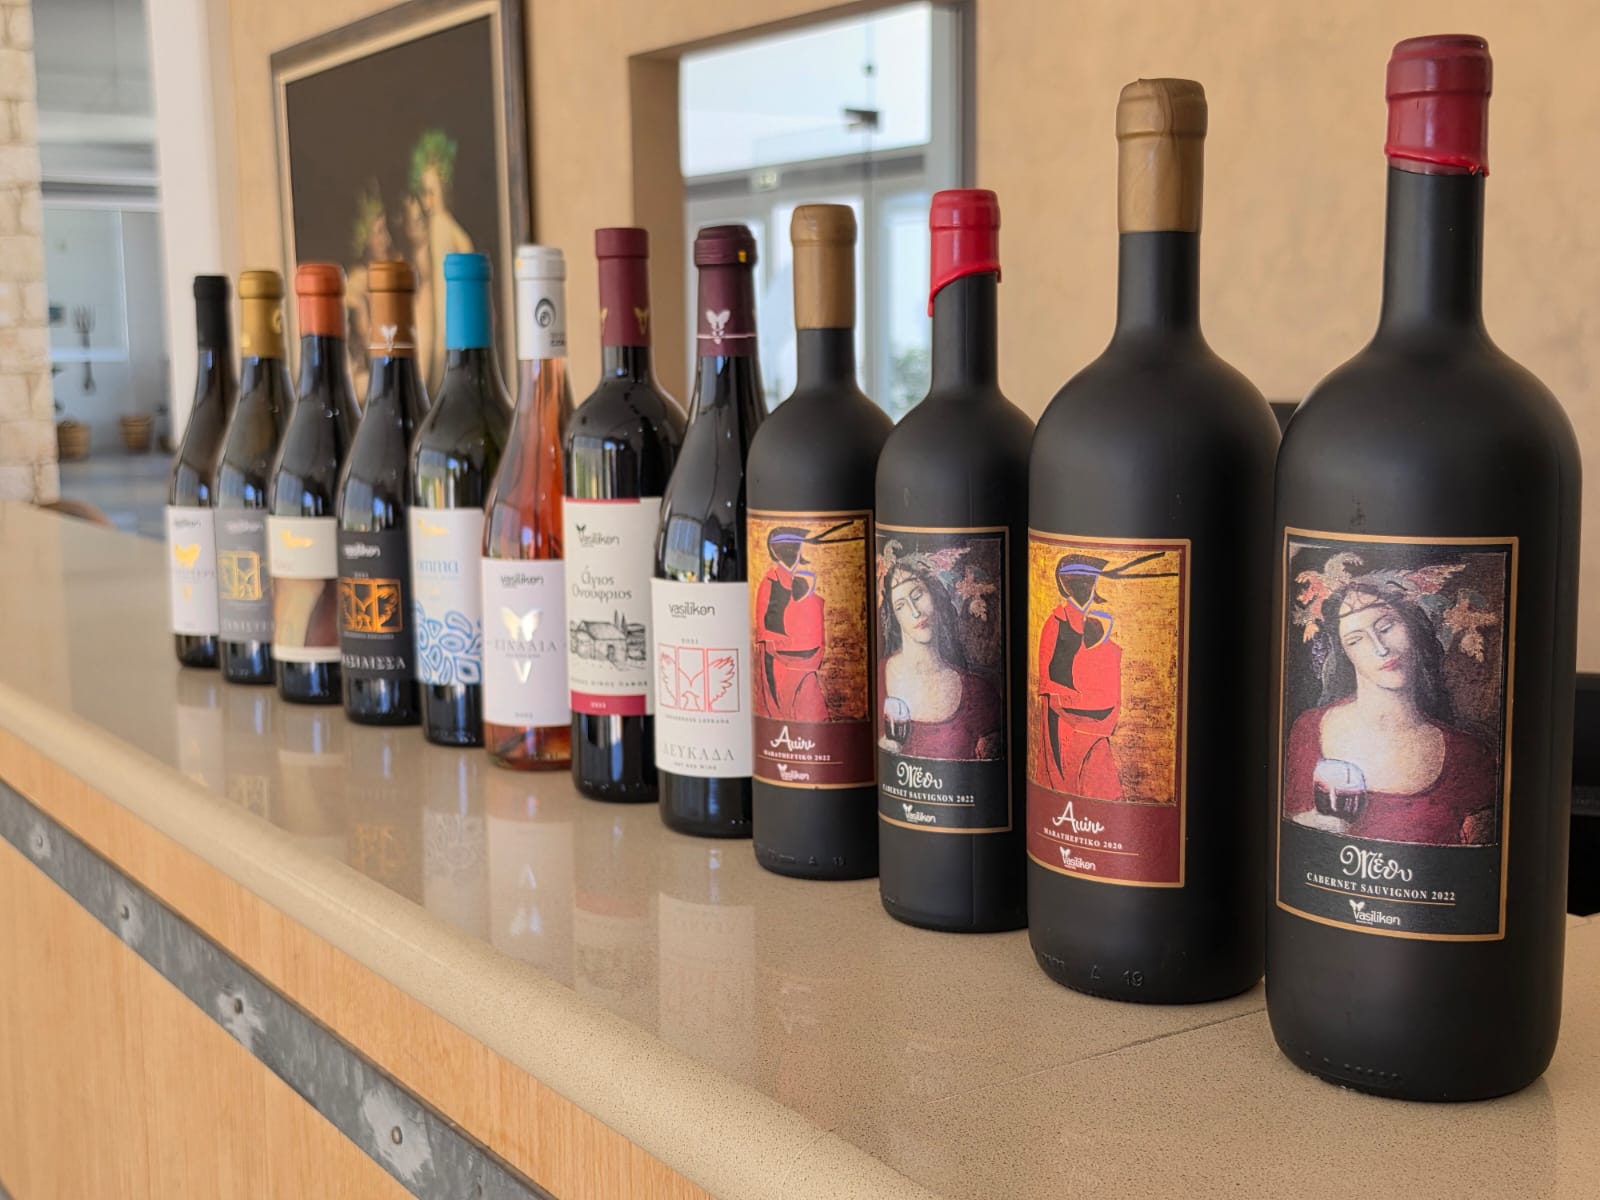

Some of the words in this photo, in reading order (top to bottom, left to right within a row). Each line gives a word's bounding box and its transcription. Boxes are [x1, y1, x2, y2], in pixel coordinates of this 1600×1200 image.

[882, 783, 908, 797] CABERNET
[908, 790, 954, 802] SAUVIGNON
[1043, 827, 1101, 847] MARATHEFTIKO
[1103, 841, 1122, 850] 2020
[1306, 872, 1357, 891] CABERNET
[1360, 884, 1428, 899] SAUVIGNON
[1431, 891, 1456, 900] 2022
